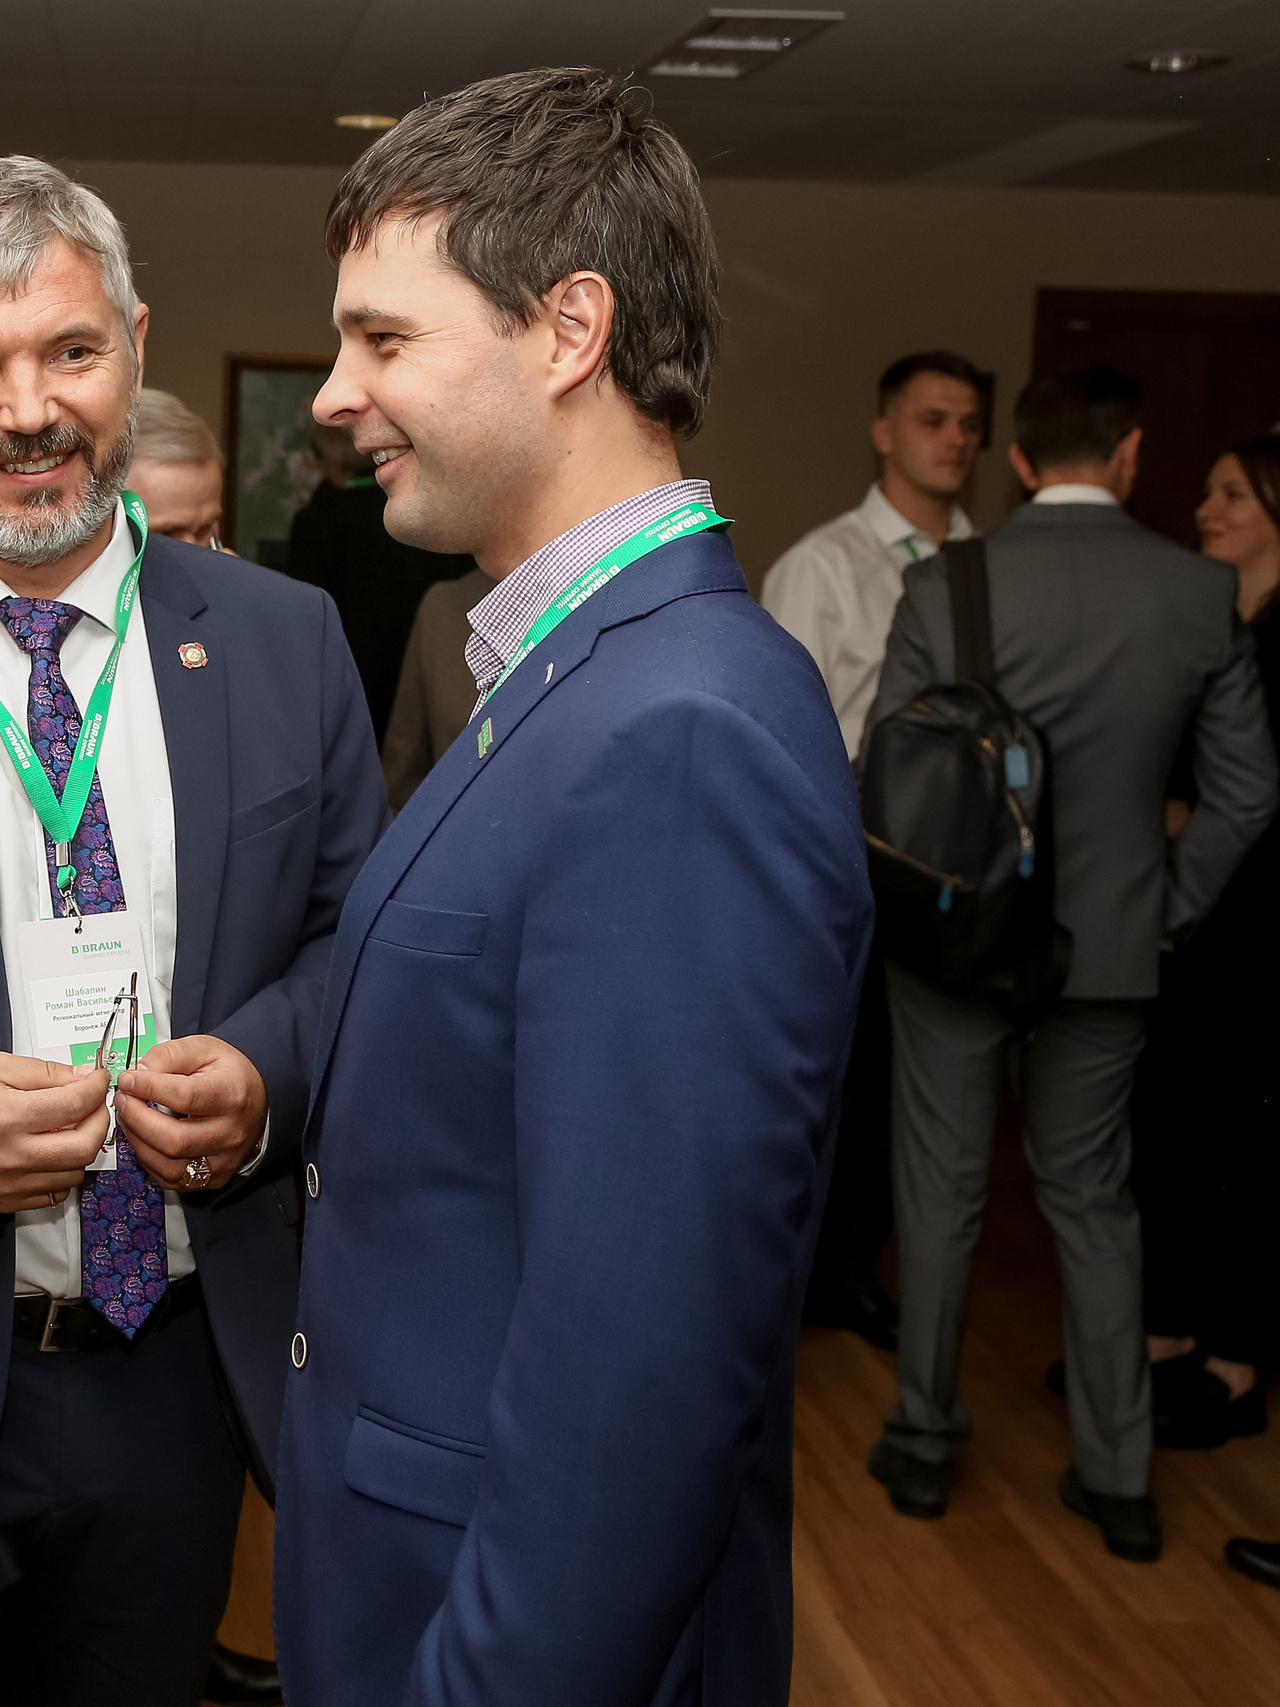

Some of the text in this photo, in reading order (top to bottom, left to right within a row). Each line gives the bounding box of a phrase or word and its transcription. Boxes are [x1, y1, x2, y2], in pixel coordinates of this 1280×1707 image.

[82, 940, 122, 953] BRAUN
[65, 986, 107, 998] Шабалин
[45, 996, 116, 1011] Роман Василье
[74, 1024, 99, 1032] Воронеж
